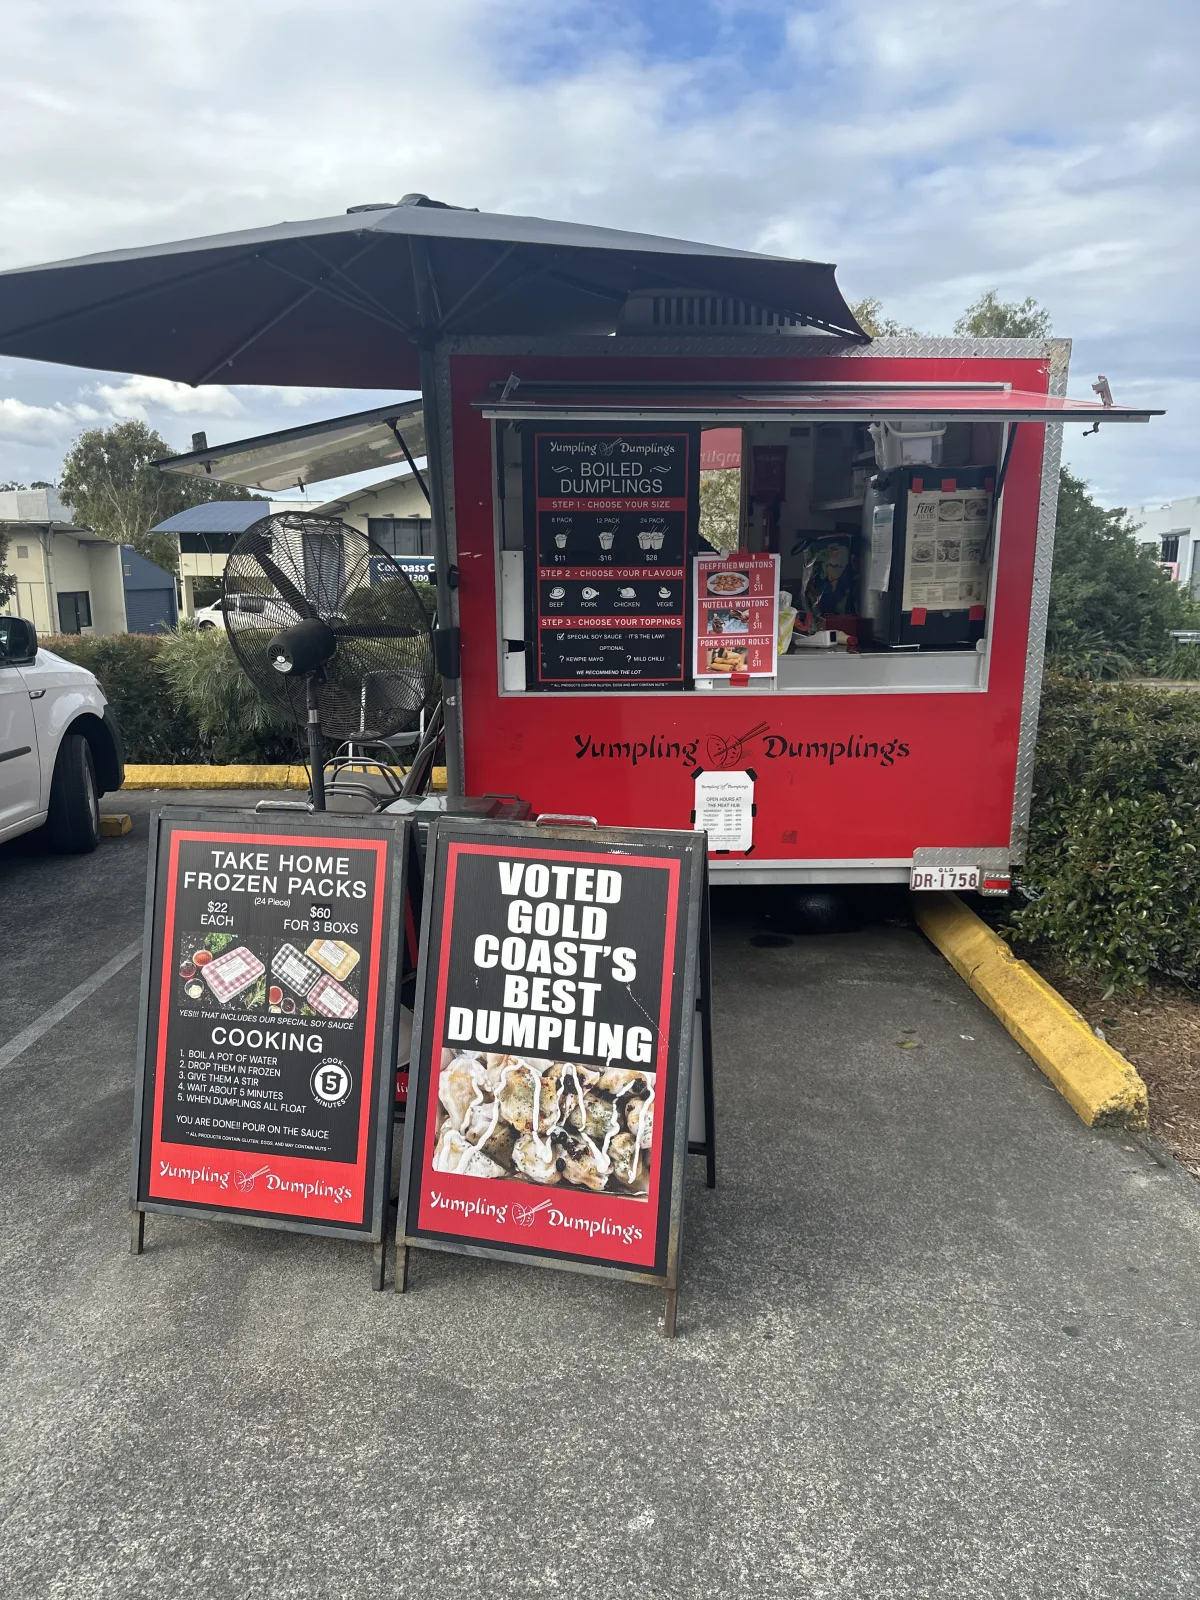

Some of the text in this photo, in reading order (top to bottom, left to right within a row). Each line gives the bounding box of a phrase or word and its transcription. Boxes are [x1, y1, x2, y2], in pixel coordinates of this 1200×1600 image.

[550, 441, 675, 457] Yumpling Dumplings
[580, 462, 643, 477] BOILED
[560, 478, 663, 494] DUMPLINGS
[552, 500, 575, 509] STEP
[587, 500, 622, 509] CHOOSE
[624, 500, 649, 509] YOUR
[651, 500, 671, 509] SIZE
[554, 554, 566, 562] $11
[600, 554, 612, 562] $16
[738, 560, 772, 568] WONTONS
[409, 574, 429, 582] 1300
[540, 569, 683, 577] STEP 2 CHOOSE YOUR FLAVOUR
[753, 583, 763, 591] $11
[702, 599, 768, 608] NUTELLA WONTONS
[541, 618, 682, 626] STEP 3 CHOOSE YOUR TOPPINGS
[720, 638, 745, 646] SPRING
[748, 637, 769, 645] ROLLS
[752, 659, 762, 667] $11
[574, 734, 910, 767] Yumpling Dumplings
[211, 850, 350, 875] TAKE HOME
[184, 871, 367, 899] FROZEN PACKS
[498, 861, 622, 904] VOTED
[207, 900, 228, 913] $22
[254, 896, 291, 908] (24 Piece)
[200, 913, 234, 927] EACH
[309, 906, 331, 919] $60
[507, 899, 608, 941] GOLD
[283, 919, 359, 934] FOR 3 BOXS
[503, 974, 602, 1017] BEST
[179, 1009, 354, 1030] YES!!! THAT INCLUDES OUR SPECIAL SOY SAUCE
[211, 1026, 323, 1053] COOKING
[447, 1006, 653, 1063] DUMPLING
[180, 1048, 278, 1066] 1. BOIL A POT OF WATER
[322, 1057, 345, 1066] COOK
[179, 1059, 281, 1077] 2. DROP THEM IN FROZEN
[178, 1070, 259, 1087] 3. GIVE THEM A STIR
[325, 1075, 337, 1091] 5
[177, 1082, 284, 1101] 4. WAIT ABOUT 5 MINUTES
[177, 1092, 307, 1114] 5. WHEN DUMPLINGS ALL FLOAT
[314, 1095, 346, 1109] MINUTES
[176, 1115, 329, 1140] YOU ARE DONE!! POUR ON THE SAUCE
[159, 1160, 352, 1204] Yumpling Dumplings
[430, 1191, 643, 1245] Yumpling Dumplings
